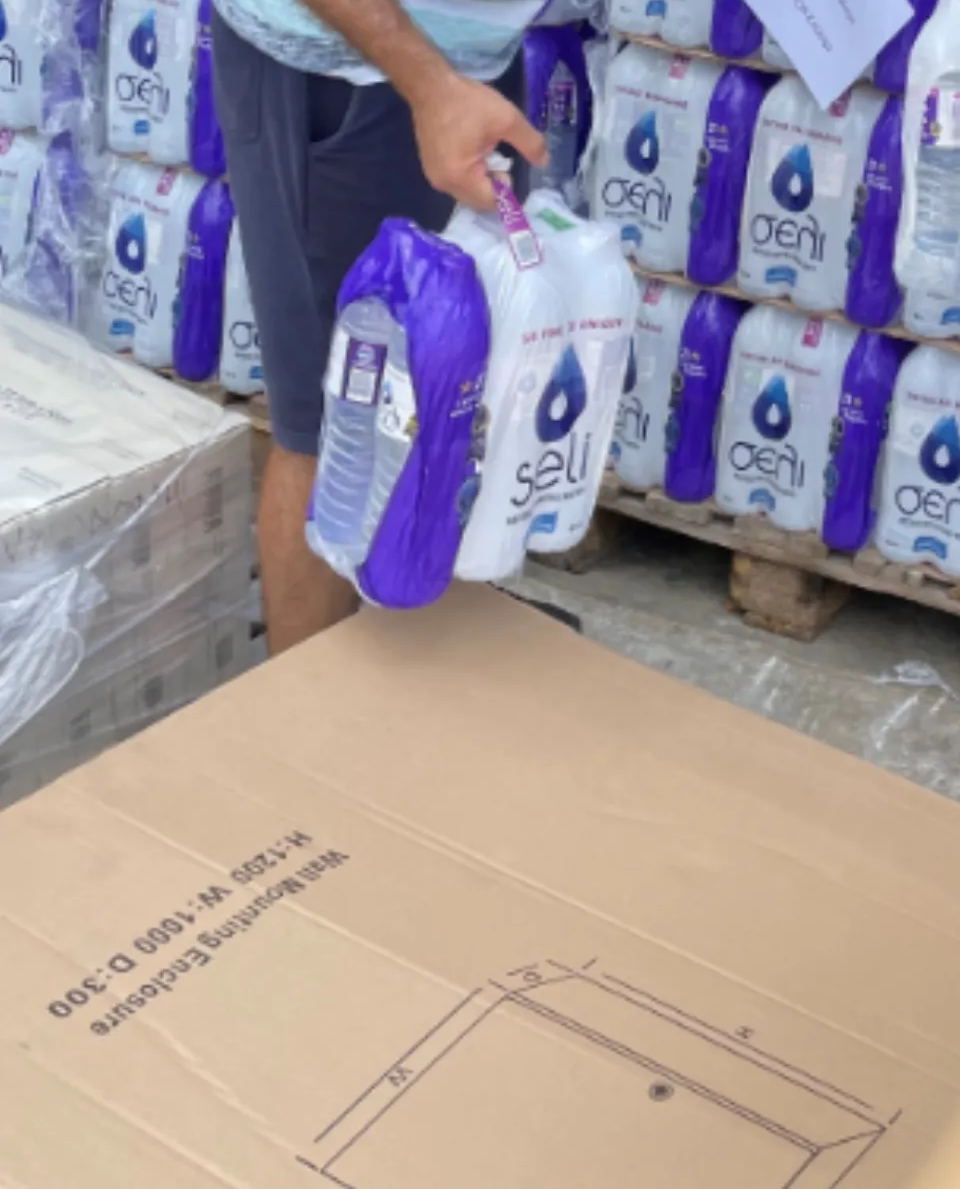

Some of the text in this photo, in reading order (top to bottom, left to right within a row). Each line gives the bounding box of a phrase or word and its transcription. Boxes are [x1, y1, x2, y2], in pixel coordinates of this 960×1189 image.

[510, 431, 592, 508] seli
[90, 848, 350, 1037] Wall Mounting Enclosure
[133, 884, 233, 955] W:1000
[47, 953, 138, 1020] D:300
